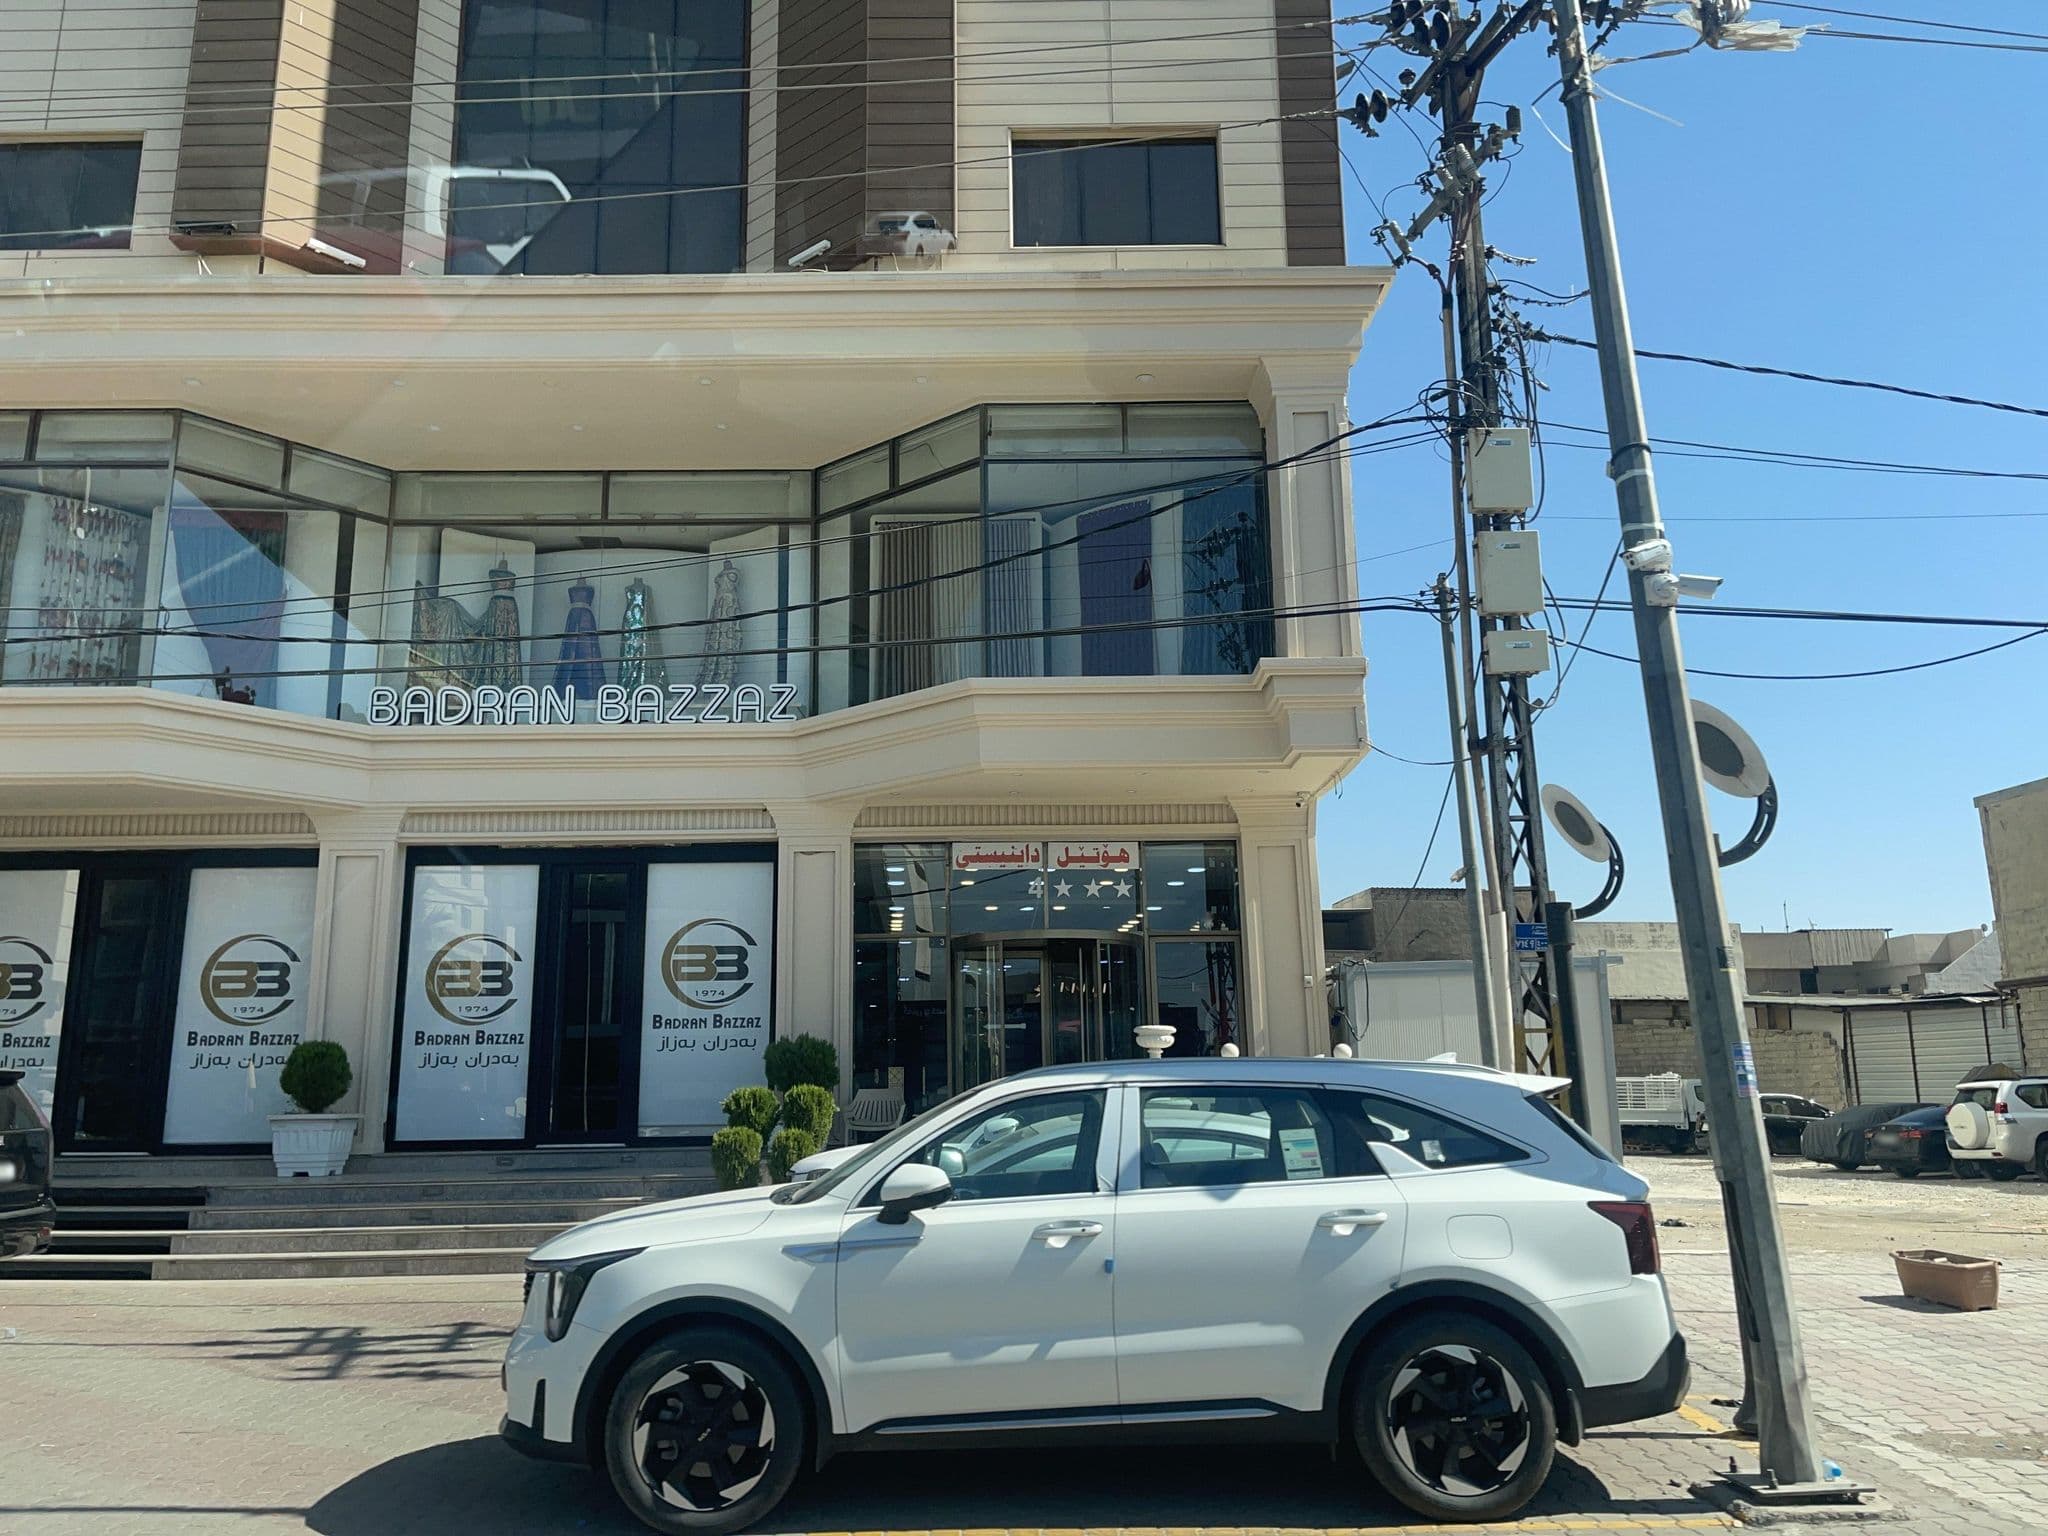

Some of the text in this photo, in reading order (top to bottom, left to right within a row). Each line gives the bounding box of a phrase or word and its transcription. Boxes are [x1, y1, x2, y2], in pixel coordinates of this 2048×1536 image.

[370, 683, 798, 726] BADRAN BAZZAZ
[1027, 876, 1044, 899] 4
[652, 1013, 762, 1030] BADRAN BAZZAZ
[2, 1032, 51, 1048] BAZZAZ
[187, 1030, 299, 1046] BADRAN BAZZAZ
[414, 1029, 525, 1046] BADRAN BAZZAZ
[656, 1035, 757, 1052] بەدران بەزاز
[189, 1053, 231, 1070] بەزاز
[417, 1052, 520, 1069] بەدران بەزاز
